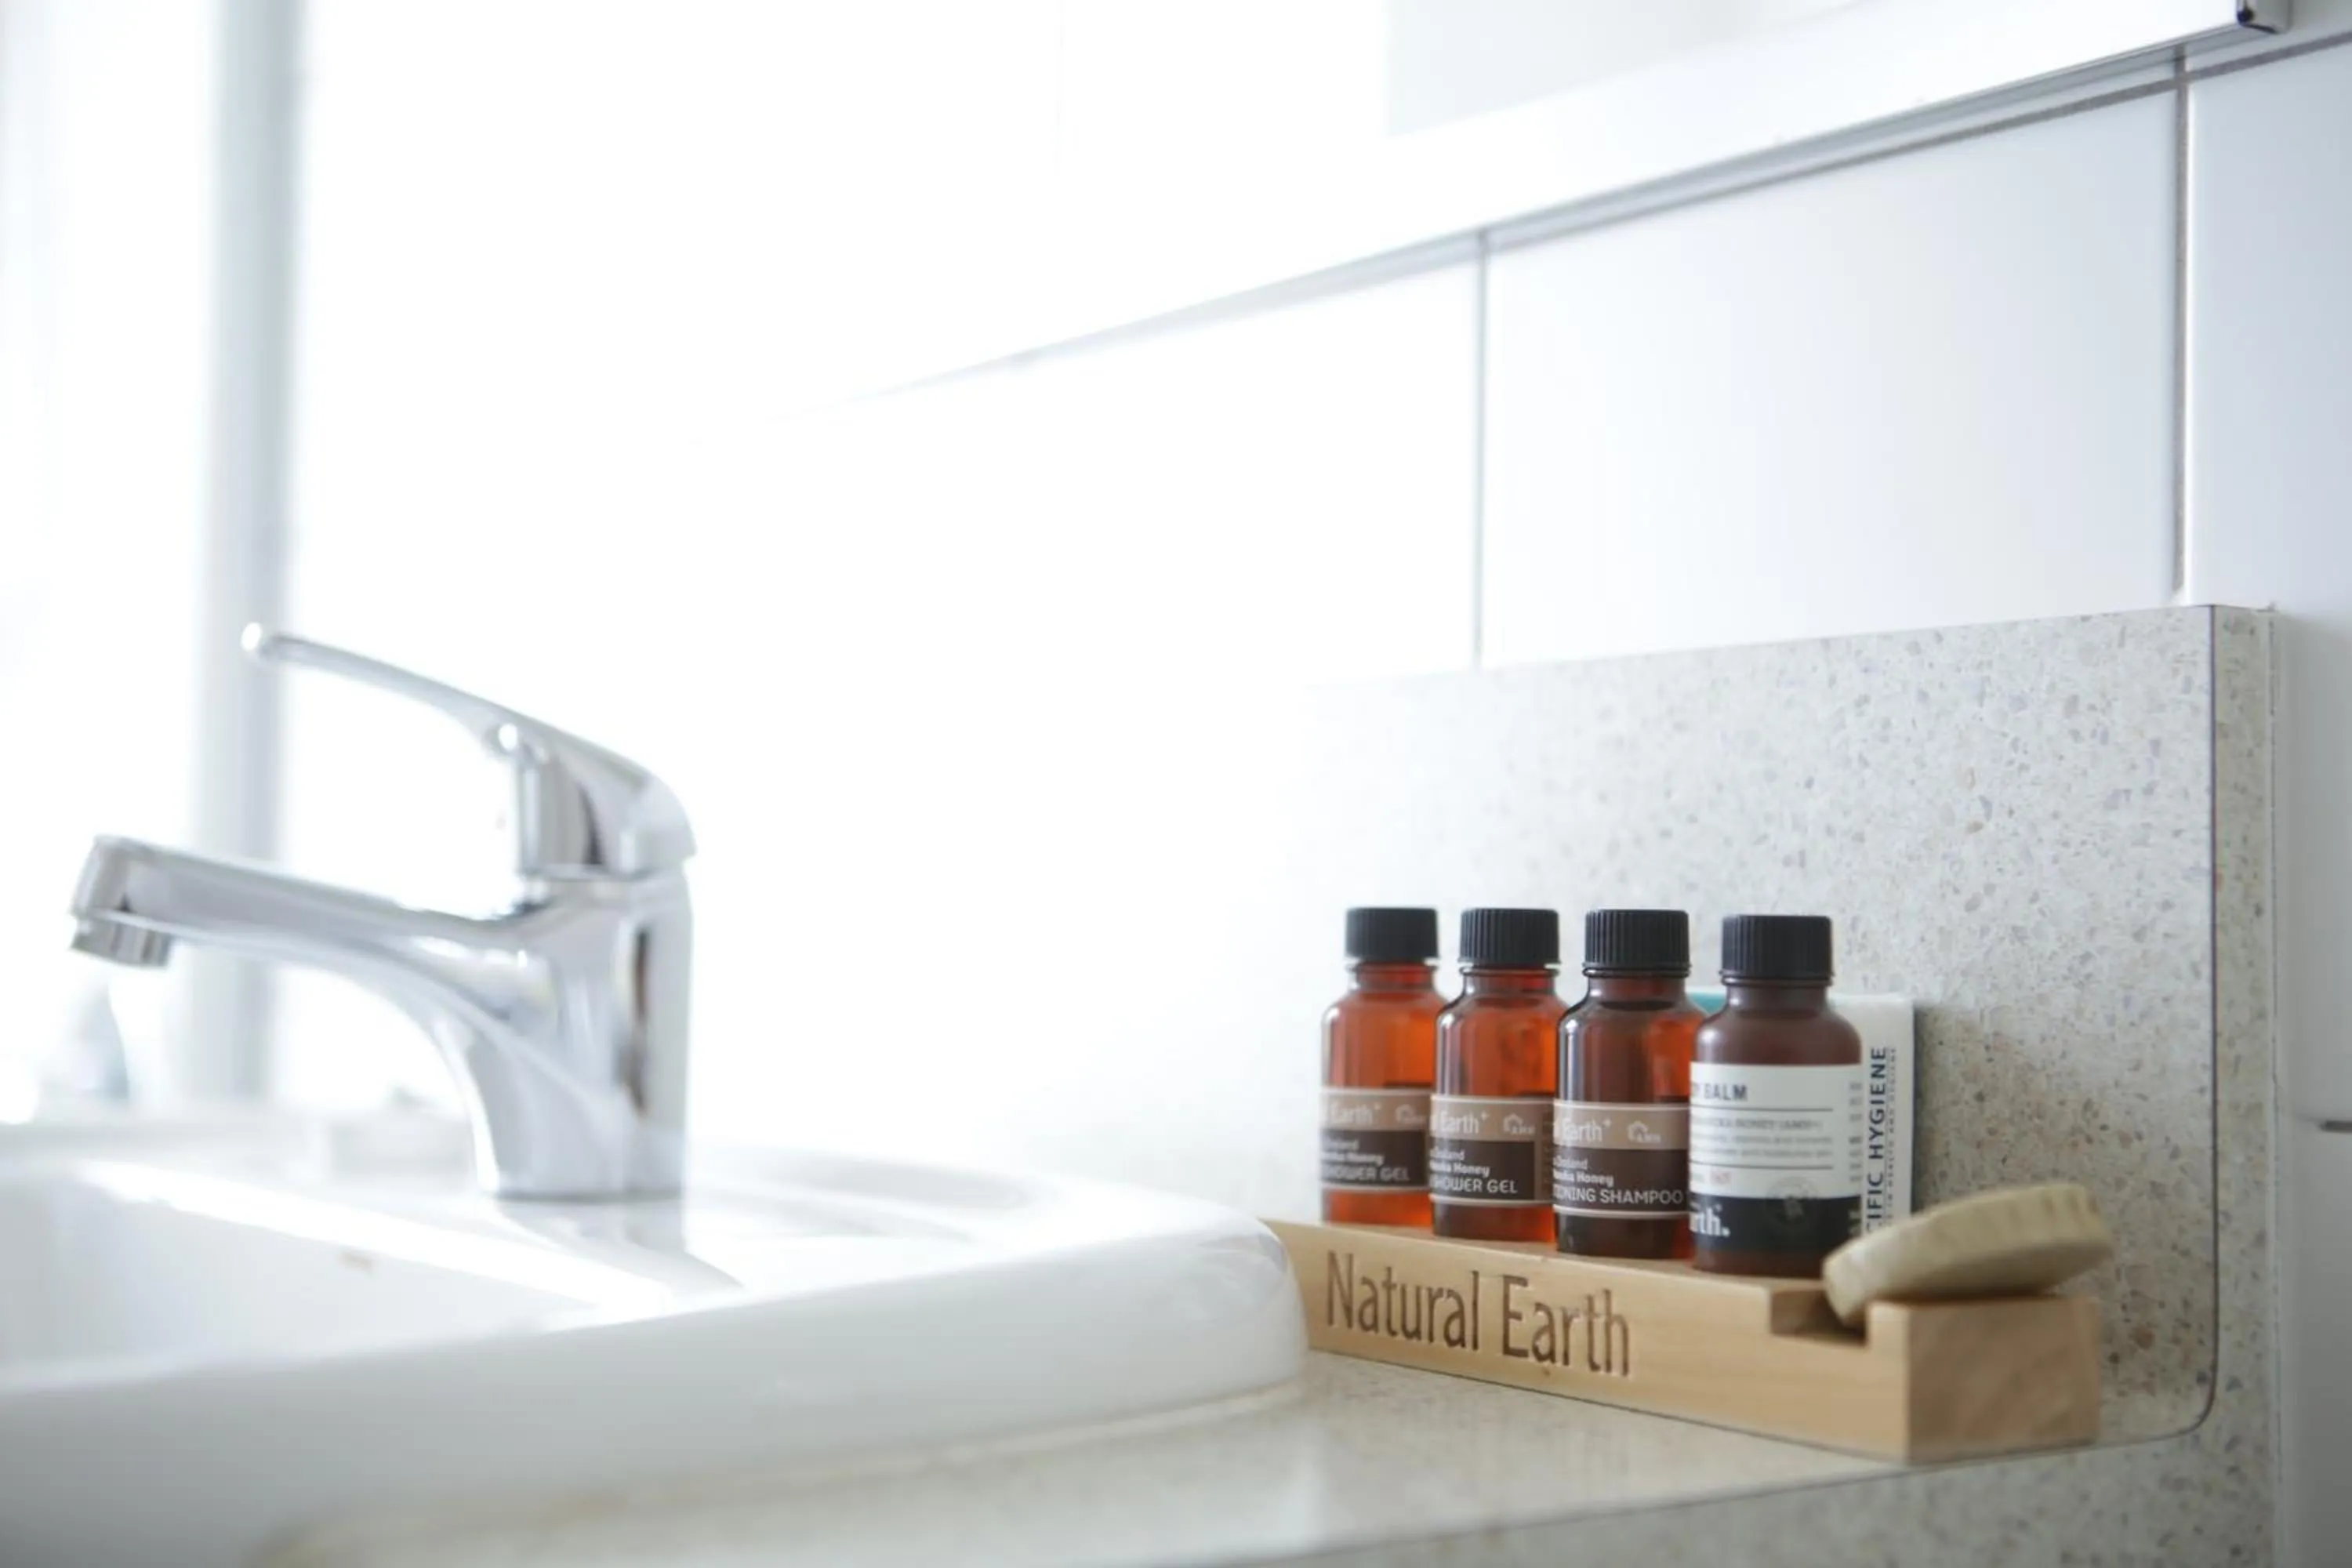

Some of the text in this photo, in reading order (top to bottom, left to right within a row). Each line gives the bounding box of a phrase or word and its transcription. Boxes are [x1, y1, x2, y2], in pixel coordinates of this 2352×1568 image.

[1704, 1083, 1748, 1102] BALM
[1868, 1047, 1887, 1160] HYGIENE
[1380, 1167, 1410, 1181] GEL
[1454, 1163, 1490, 1178] Honey
[1486, 1179, 1518, 1194] GEL
[1577, 1171, 1614, 1188] Honey
[1600, 1189, 1683, 1205] SHAMPOO
[1327, 1250, 1631, 1377] Natural Earth
